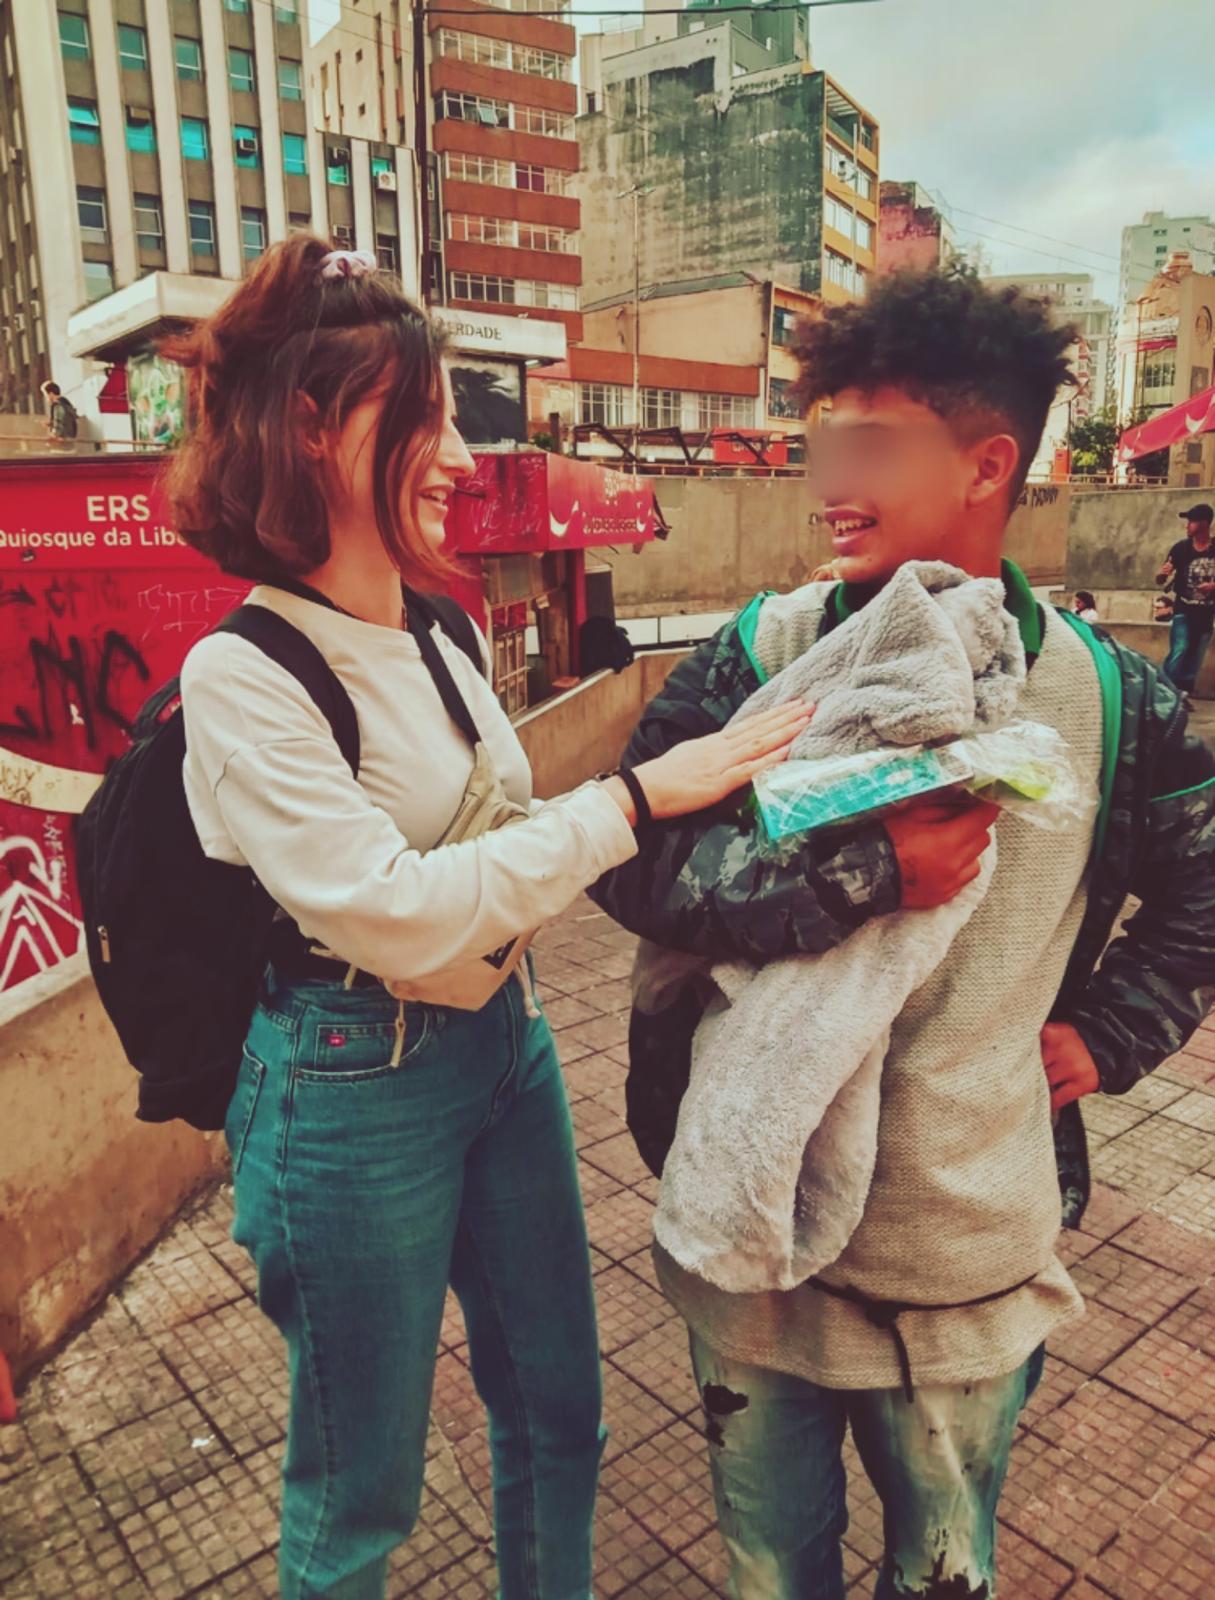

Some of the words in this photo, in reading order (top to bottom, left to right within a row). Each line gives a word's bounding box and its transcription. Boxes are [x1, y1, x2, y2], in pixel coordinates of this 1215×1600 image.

[446, 321, 502, 341] ERDADE
[86, 494, 151, 522] ERS
[103, 526, 132, 546] da
